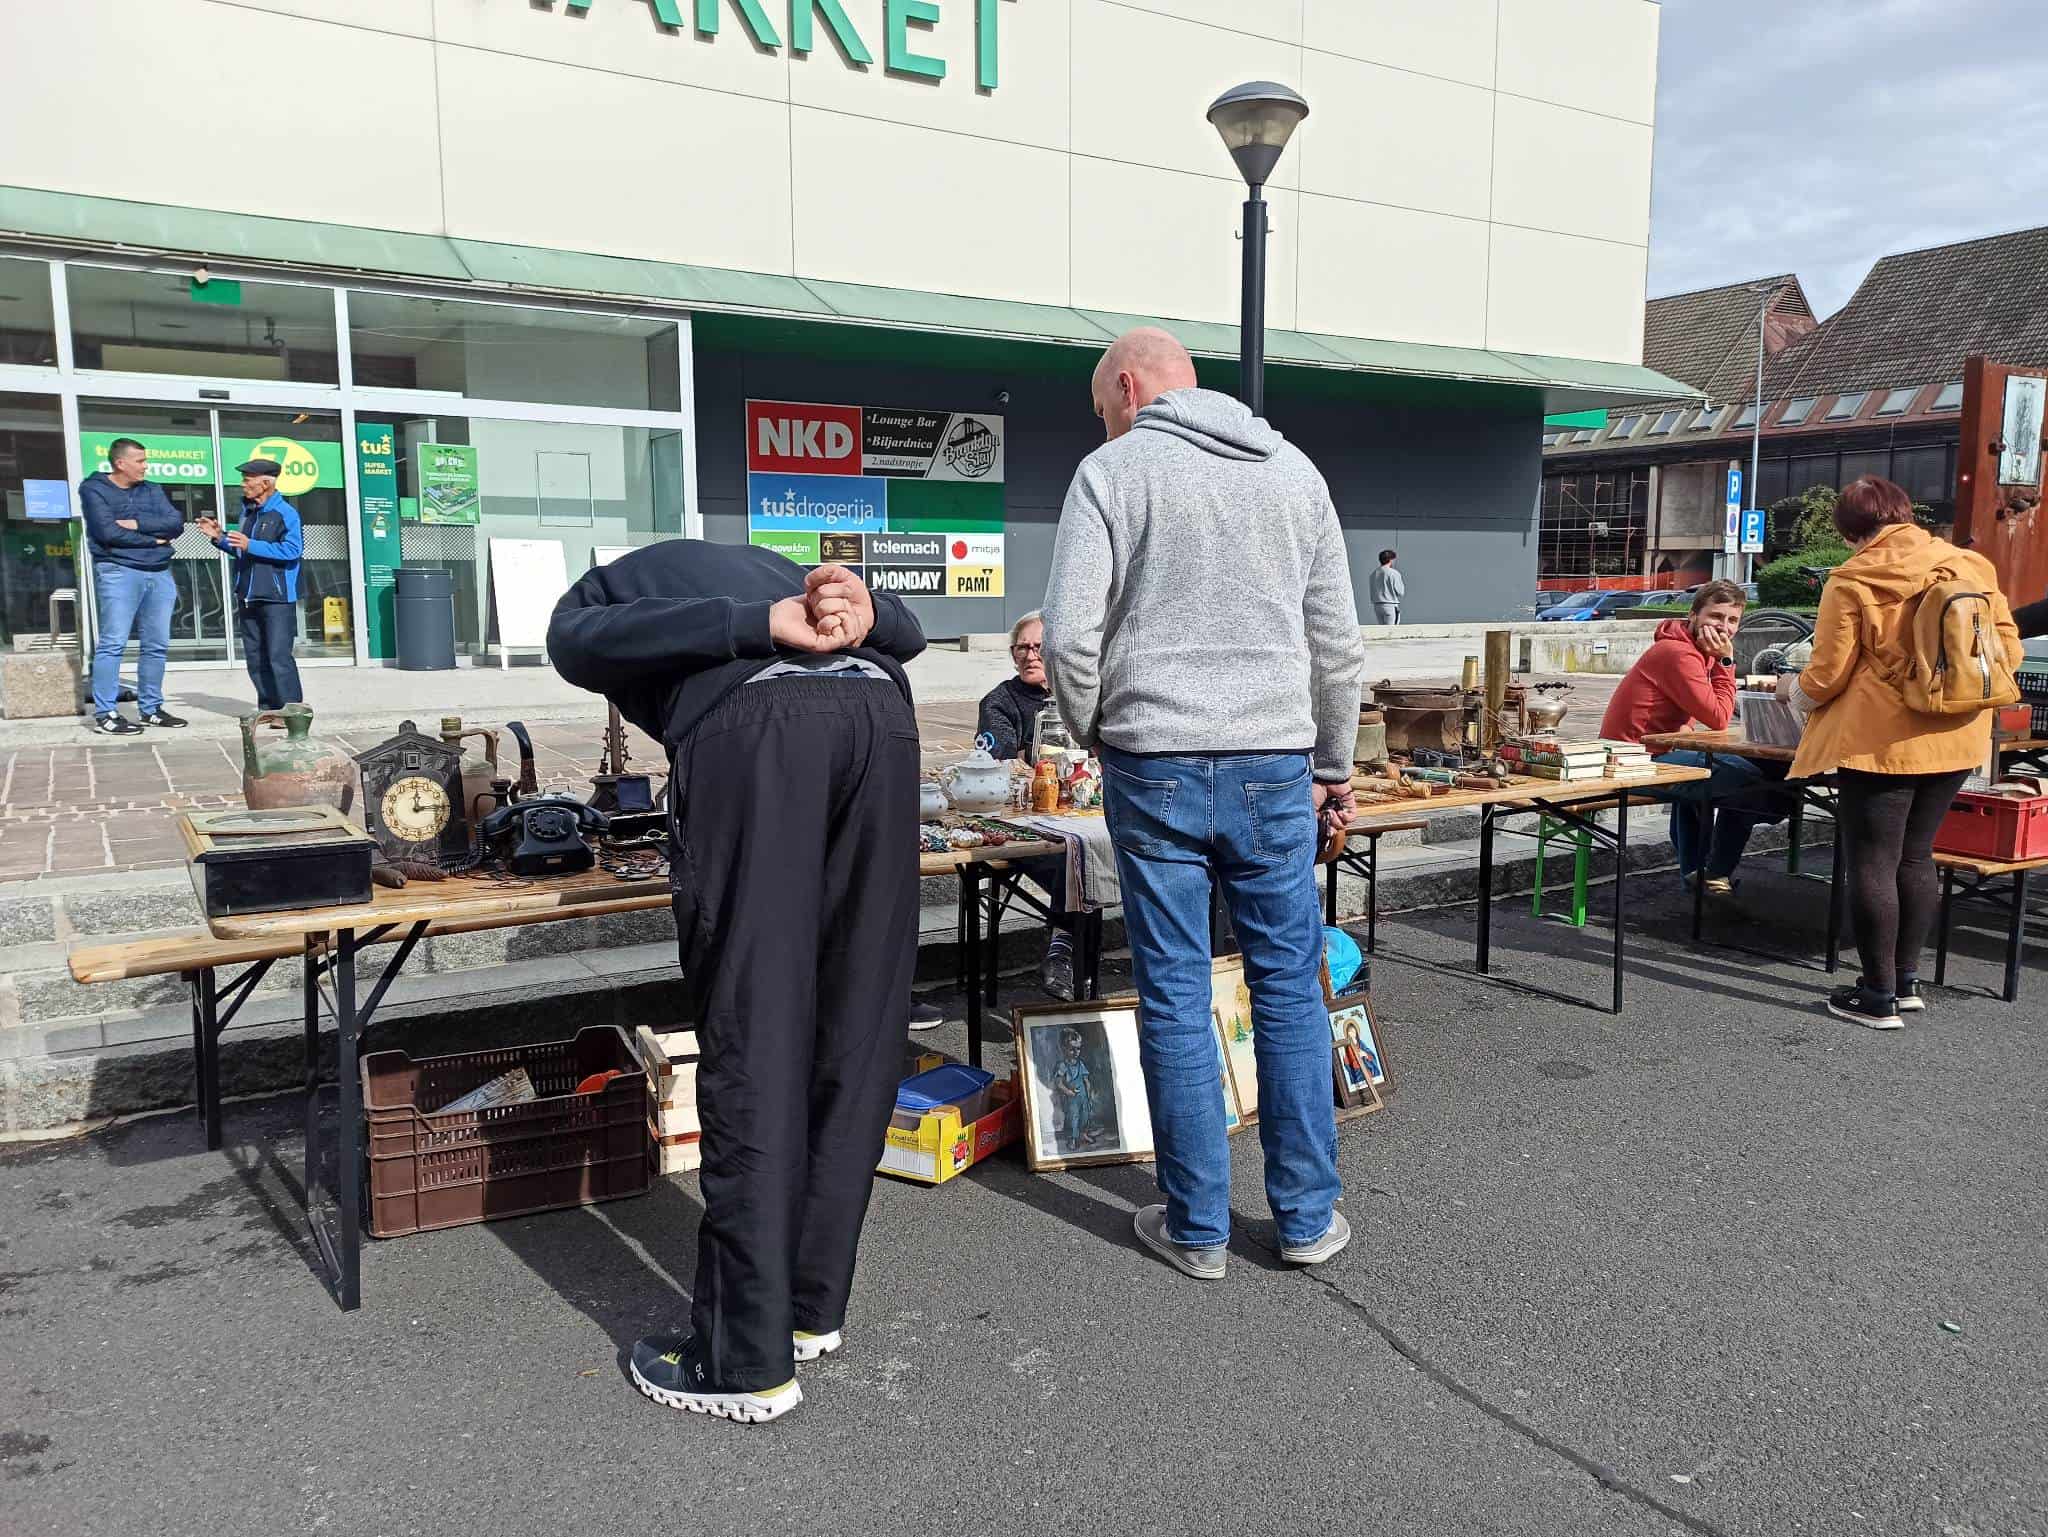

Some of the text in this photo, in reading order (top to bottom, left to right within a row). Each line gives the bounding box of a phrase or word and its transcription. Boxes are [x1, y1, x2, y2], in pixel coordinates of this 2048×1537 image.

[872, 413, 937, 428] Lounge Bar
[757, 417, 854, 459] NKD
[872, 435, 933, 449] Biljardnica
[178, 462, 209, 478] OD
[1731, 474, 1739, 499] P
[1747, 513, 1759, 530] P
[872, 539, 940, 555] telemach
[872, 570, 942, 591] MONDAY
